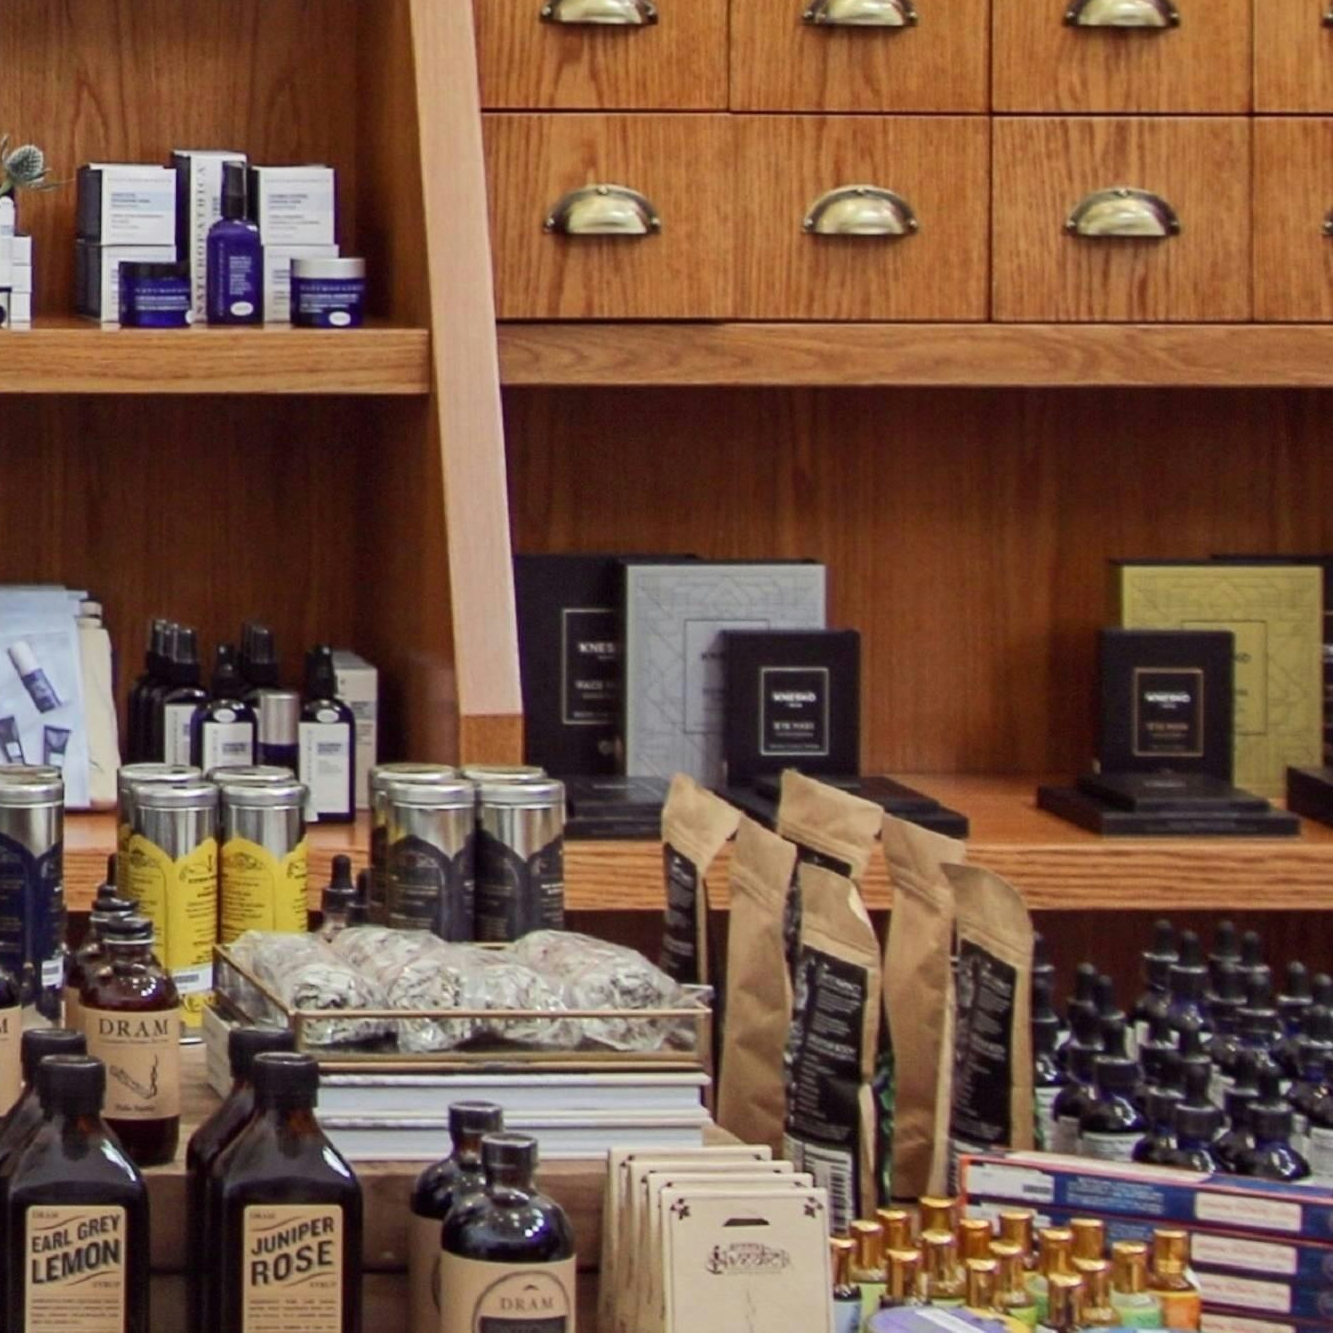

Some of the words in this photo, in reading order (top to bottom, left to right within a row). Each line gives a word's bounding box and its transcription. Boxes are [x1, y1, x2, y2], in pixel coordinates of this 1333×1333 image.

[196, 164, 206, 316] NATUROPATHICA
[578, 641, 616, 654] KNES
[98, 1018, 169, 1036] DRAM
[32, 1229, 73, 1254] EARL
[77, 1214, 121, 1241] GREY
[251, 1216, 335, 1256] JUNIPER
[32, 1238, 121, 1284] LEMON
[250, 1240, 335, 1286] ROSE
[500, 1297, 554, 1311] DRAM
